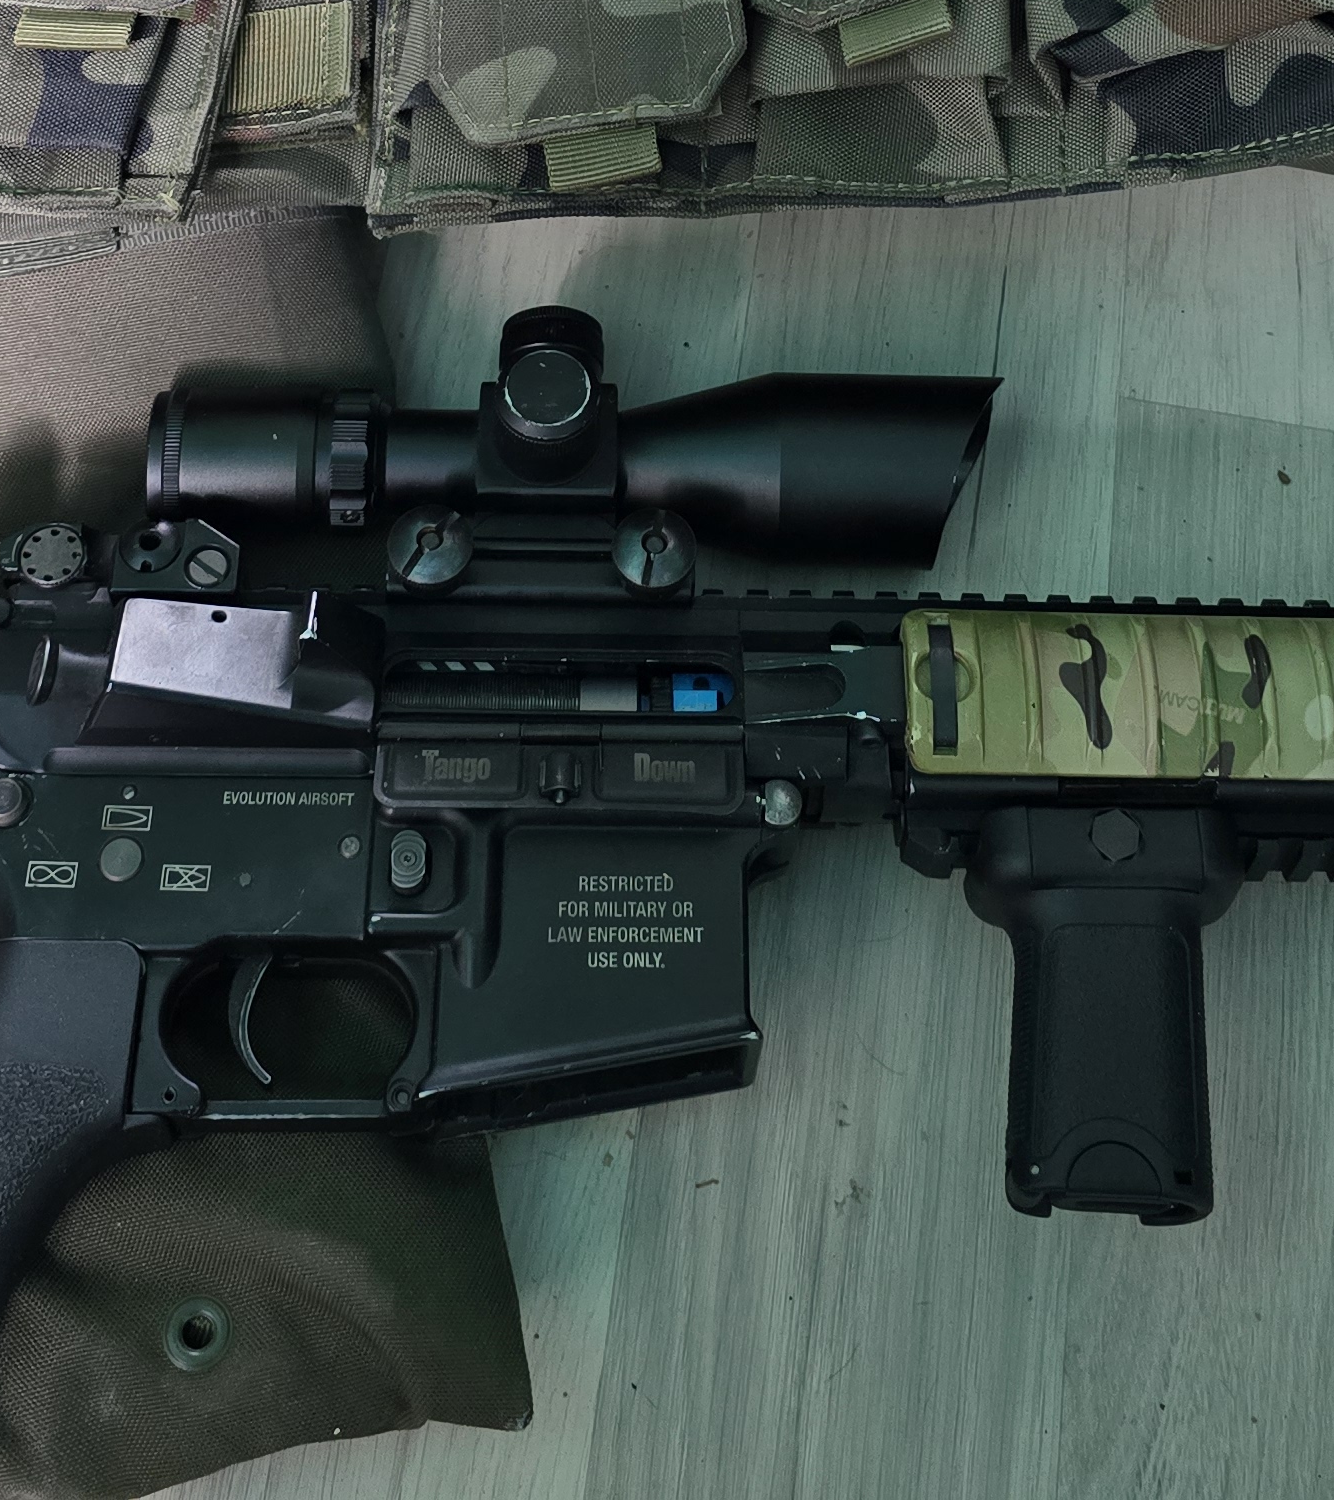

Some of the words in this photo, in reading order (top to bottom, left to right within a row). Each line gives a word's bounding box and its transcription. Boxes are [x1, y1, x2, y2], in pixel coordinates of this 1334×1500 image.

[421, 749, 491, 783] Tango
[634, 753, 695, 783] Down
[223, 791, 296, 805] EVOLUTION
[298, 792, 355, 806] AIRSOFT
[578, 874, 674, 892] RESTRICTED
[558, 901, 589, 918] FOR
[594, 901, 667, 918] MILITARY
[672, 901, 693, 918] OR
[548, 926, 583, 943] LAW
[587, 926, 704, 943] ENFORCEMENT
[587, 951, 618, 968] USE
[623, 951, 666, 968] ONLY.
